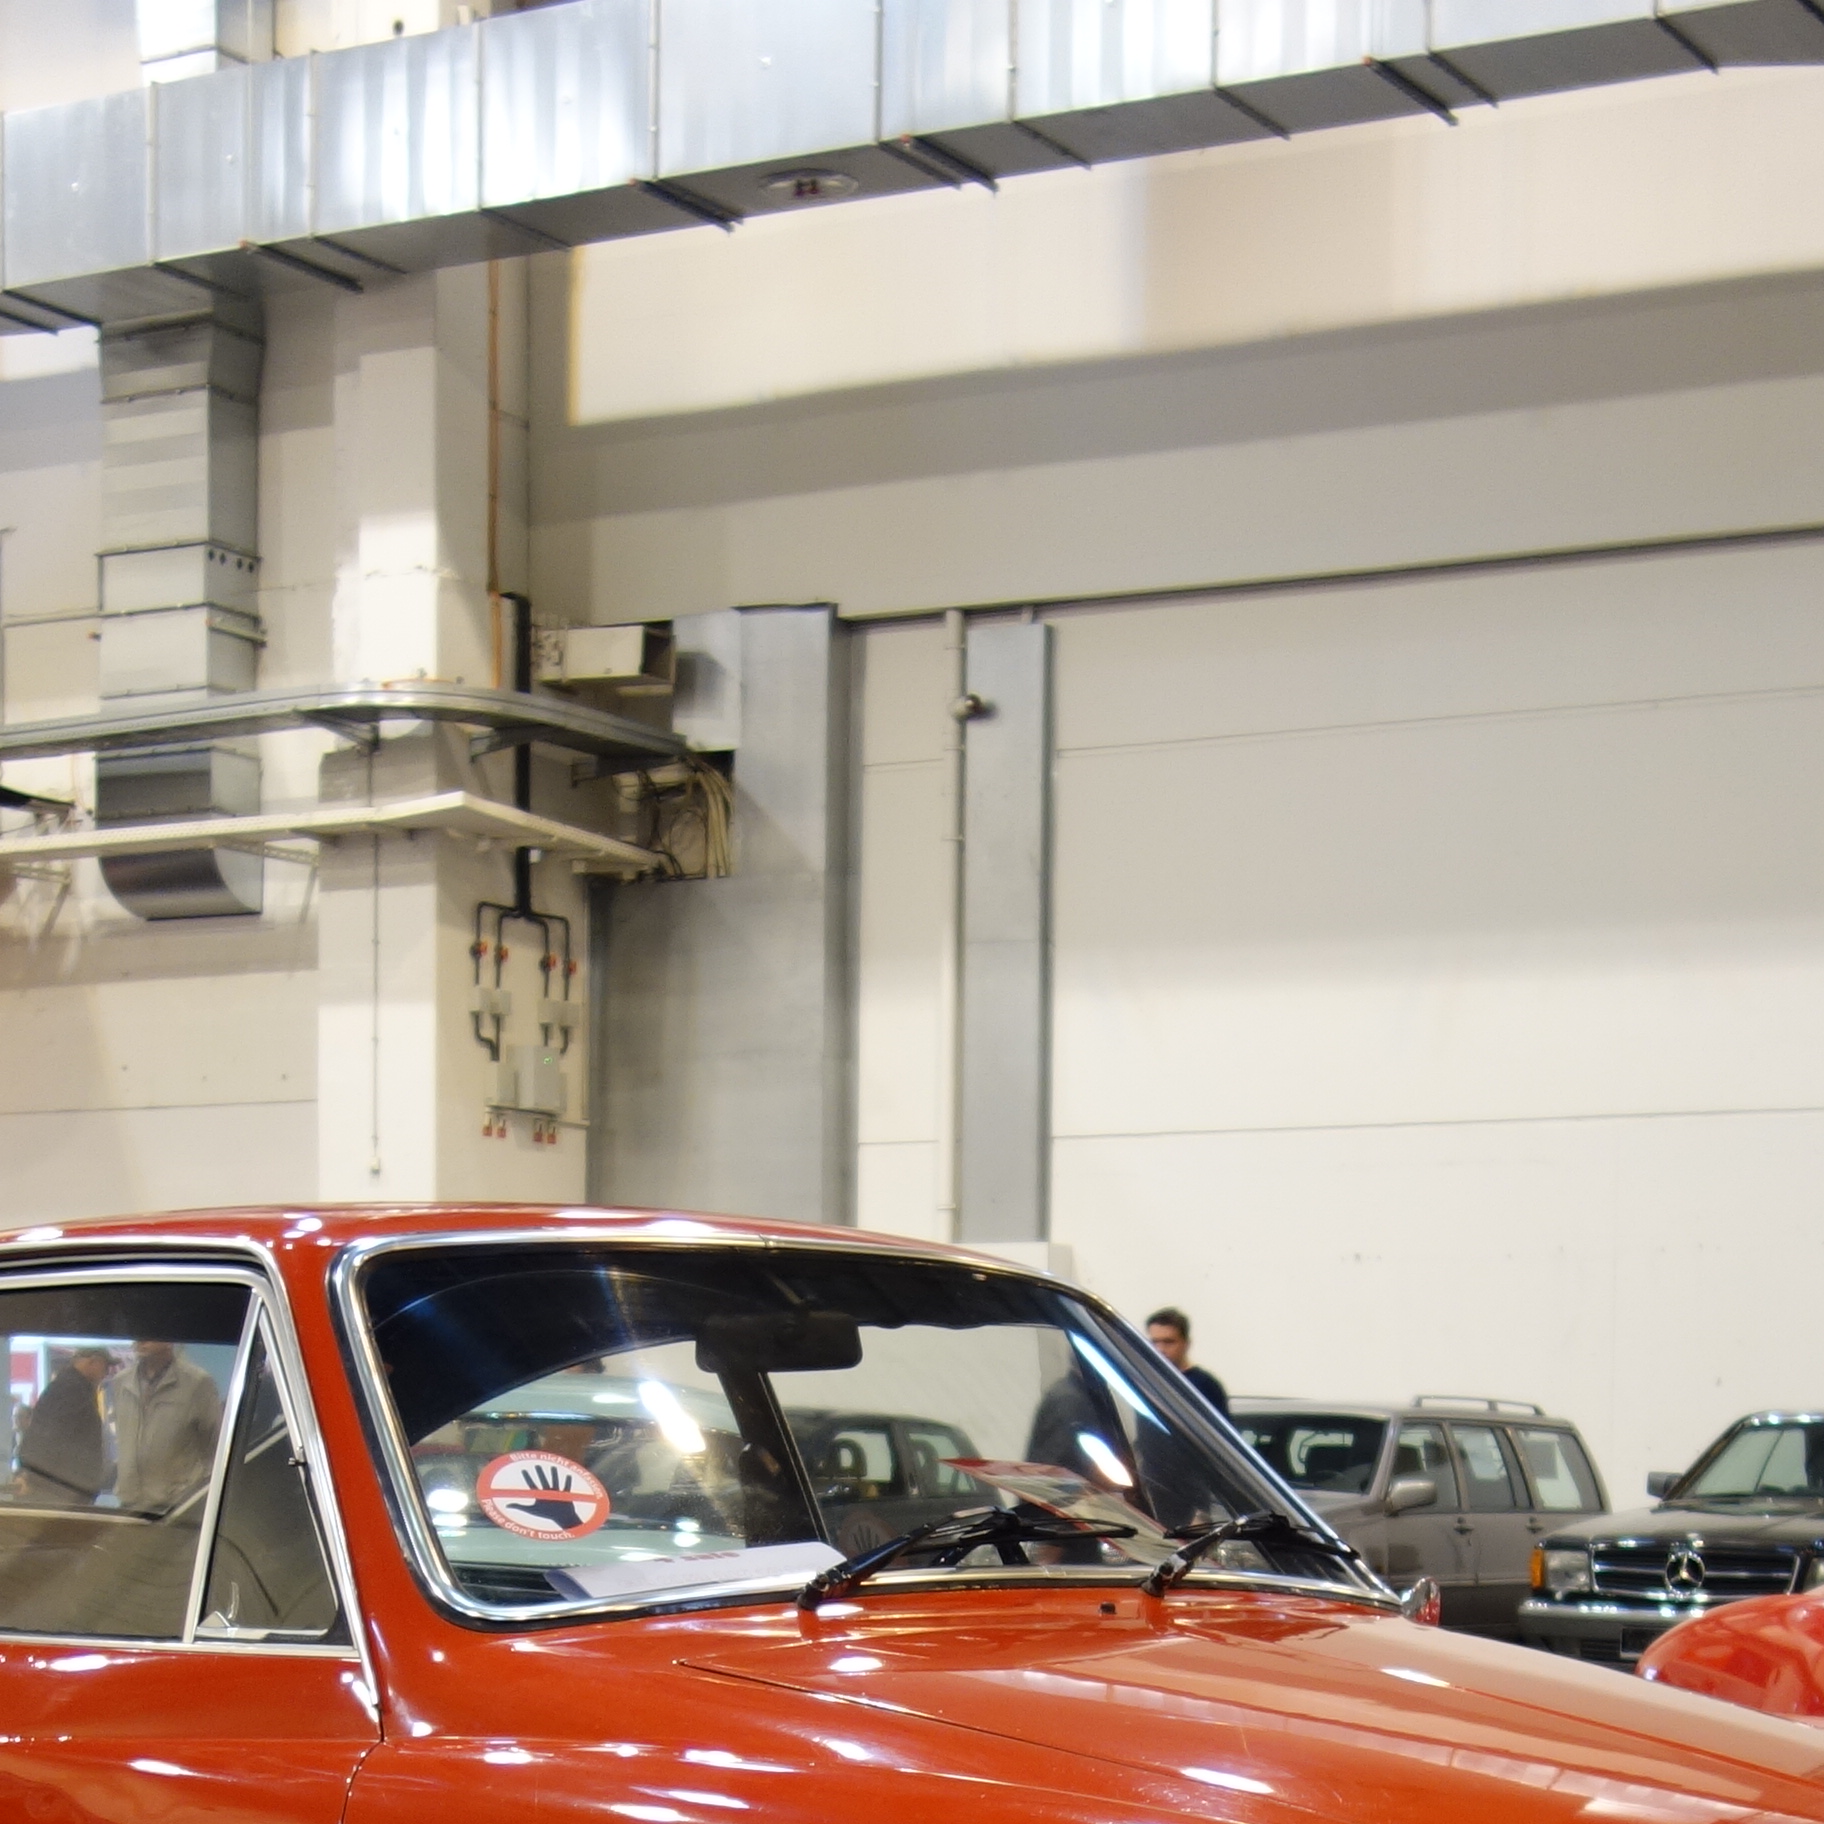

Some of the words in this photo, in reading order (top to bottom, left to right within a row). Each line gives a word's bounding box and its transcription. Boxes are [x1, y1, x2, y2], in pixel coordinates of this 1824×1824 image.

[509, 1452, 537, 1462] Bitte
[540, 1453, 570, 1466] nicht
[481, 1498, 506, 1525] Please
[505, 1521, 535, 1538] don't
